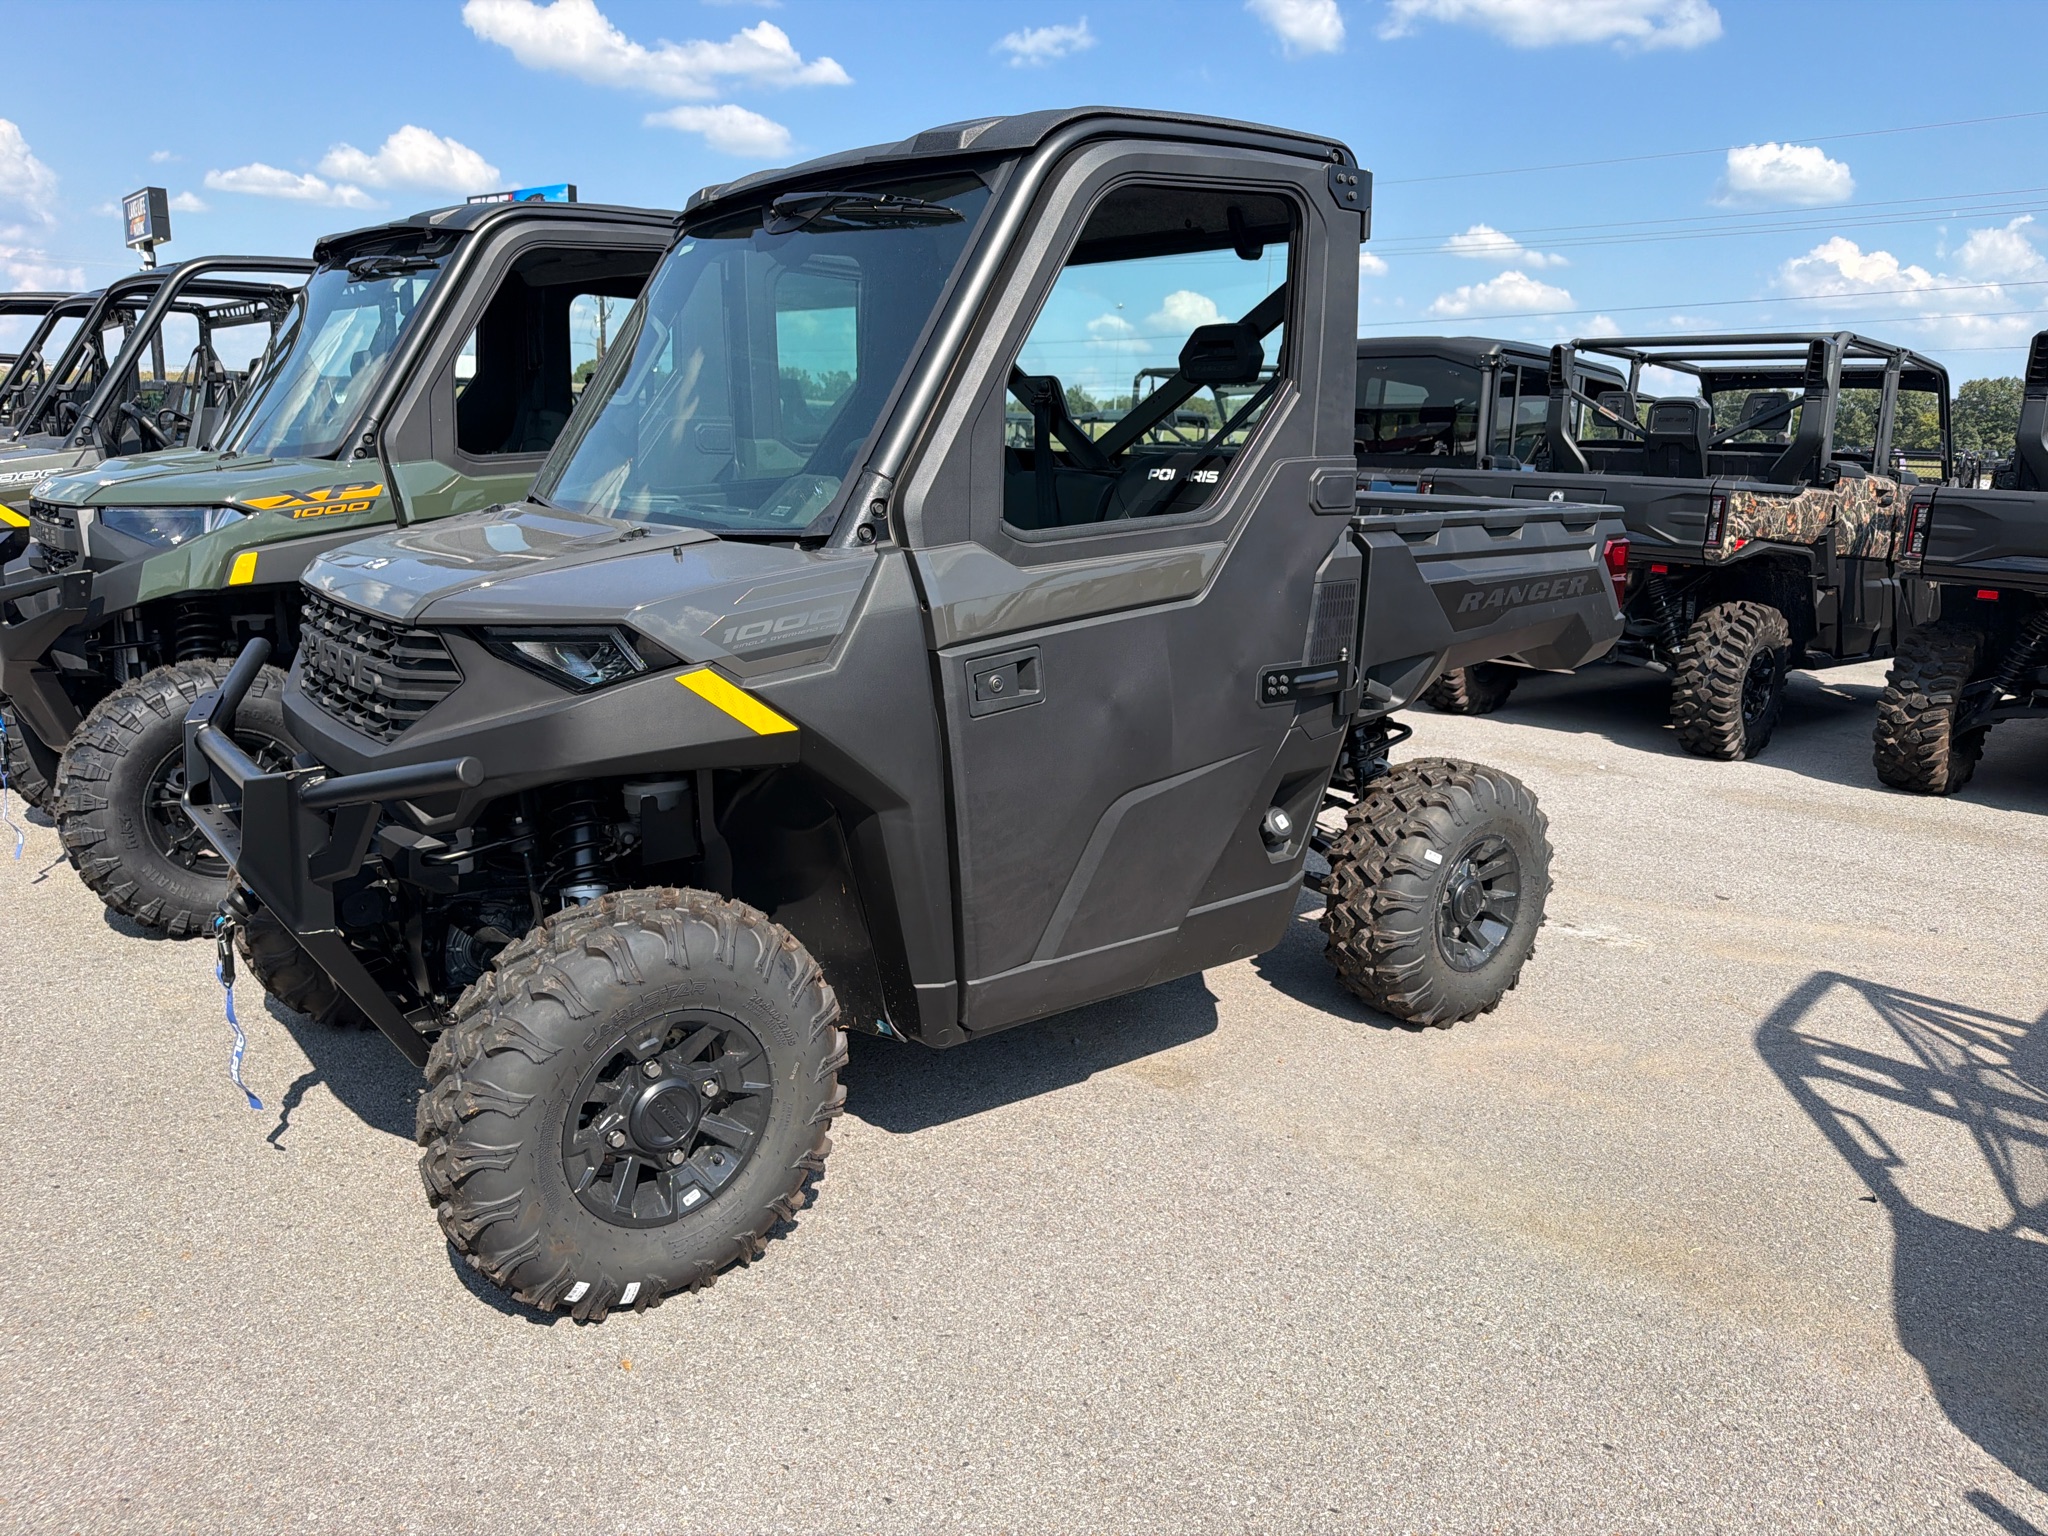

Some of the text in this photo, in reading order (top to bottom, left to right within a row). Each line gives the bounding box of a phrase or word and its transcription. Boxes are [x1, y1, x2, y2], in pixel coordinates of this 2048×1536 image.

[269, 480, 378, 507] XP
[292, 500, 370, 519] 1000
[1457, 576, 1589, 613] RANGER
[722, 605, 844, 644] 1000
[732, 637, 767, 650] SINGLE
[770, 627, 818, 641] OVERHEAD
[583, 981, 708, 1051] CARLSTAR
